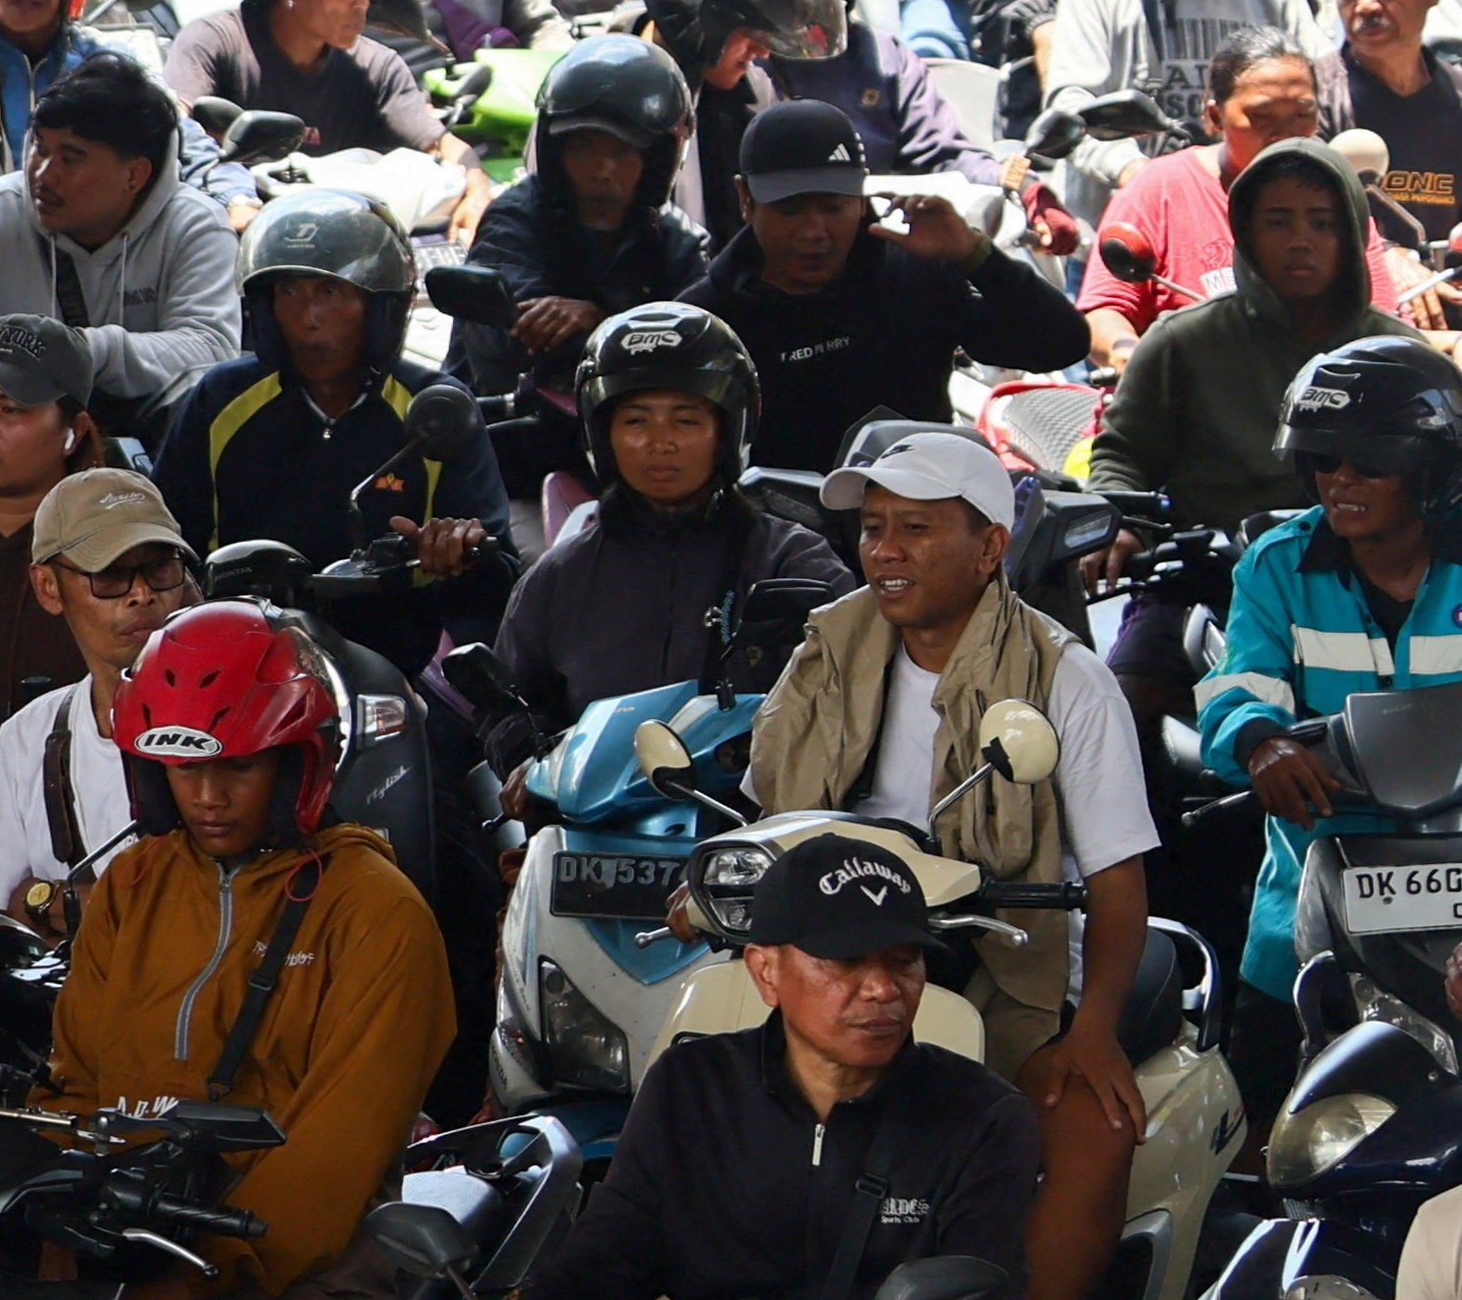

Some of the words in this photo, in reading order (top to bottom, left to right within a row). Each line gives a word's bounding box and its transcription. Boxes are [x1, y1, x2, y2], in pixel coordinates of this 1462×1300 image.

[144, 733, 214, 751] INK
[560, 856, 602, 884] DK
[819, 856, 911, 895] Callaway
[1356, 871, 1397, 899] DK
